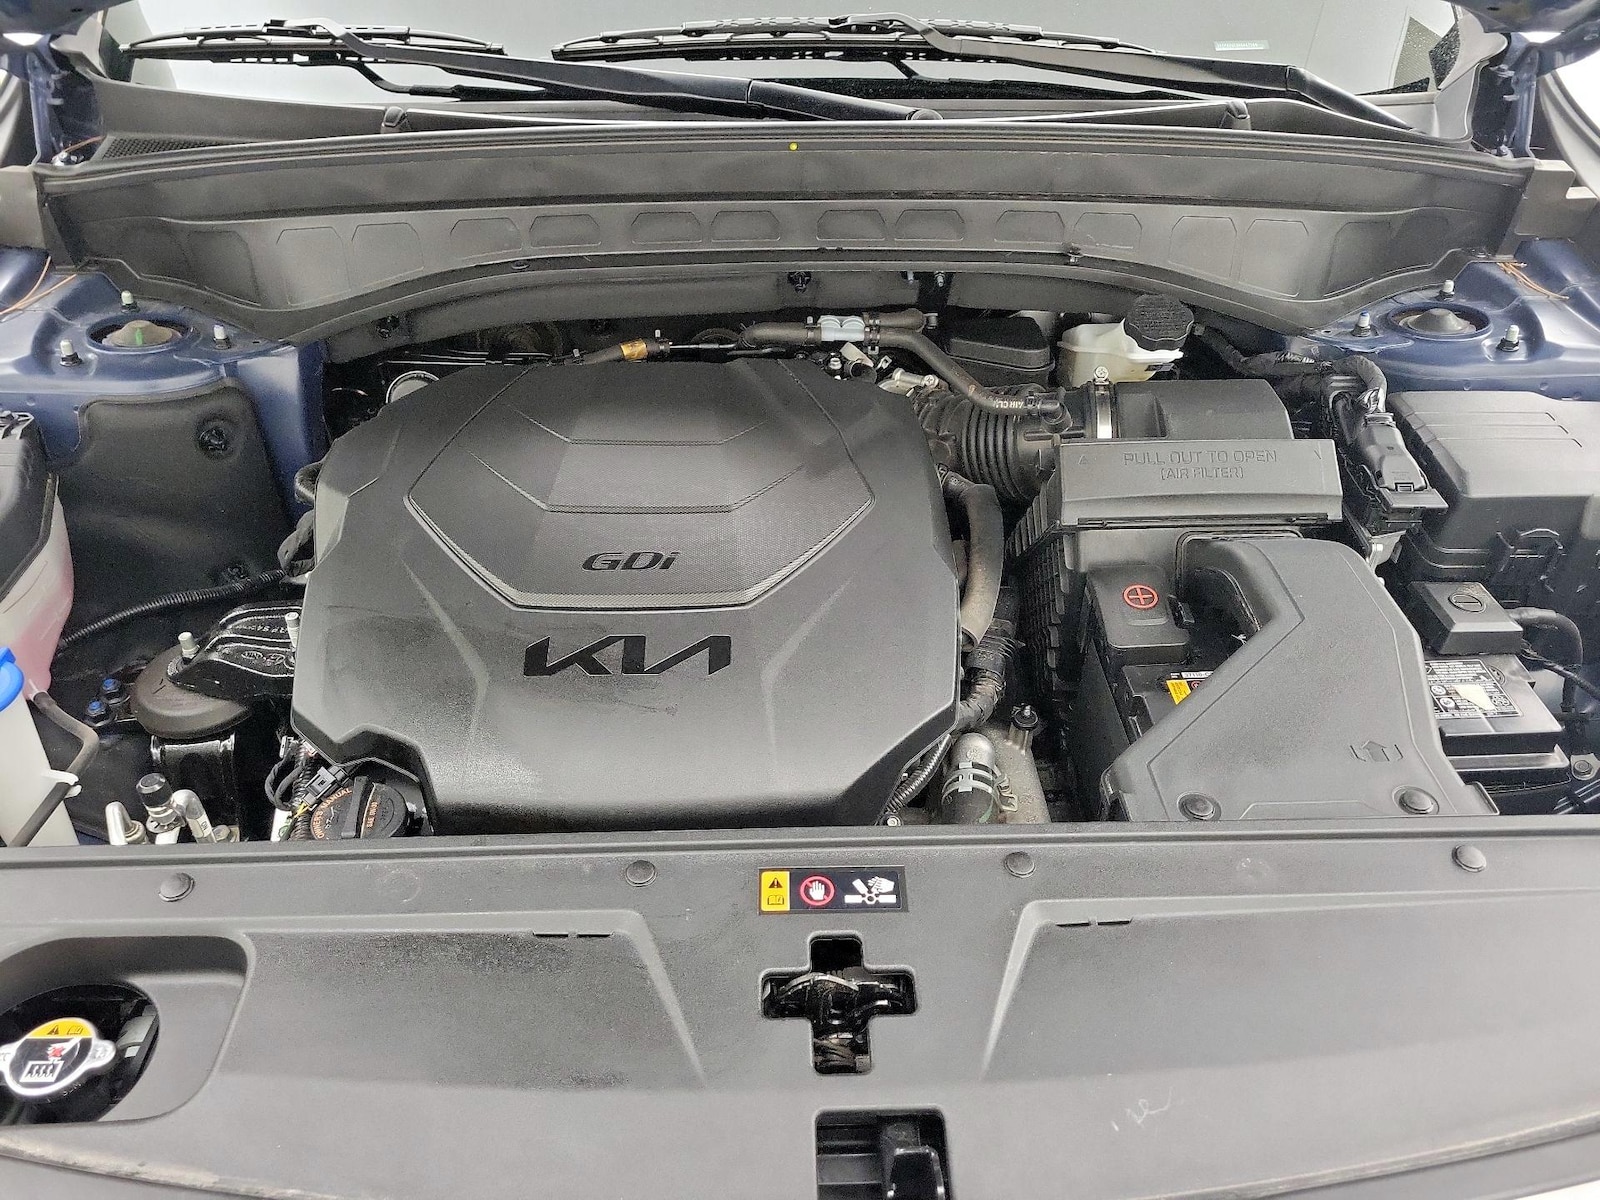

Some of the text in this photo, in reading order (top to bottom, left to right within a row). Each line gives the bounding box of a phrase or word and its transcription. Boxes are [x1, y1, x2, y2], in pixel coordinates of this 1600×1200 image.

[1123, 450, 1277, 466] PULL OUT TO OPEN
[582, 551, 680, 571] GDi
[523, 634, 732, 677] KIA
[320, 786, 353, 810] MANUAL
